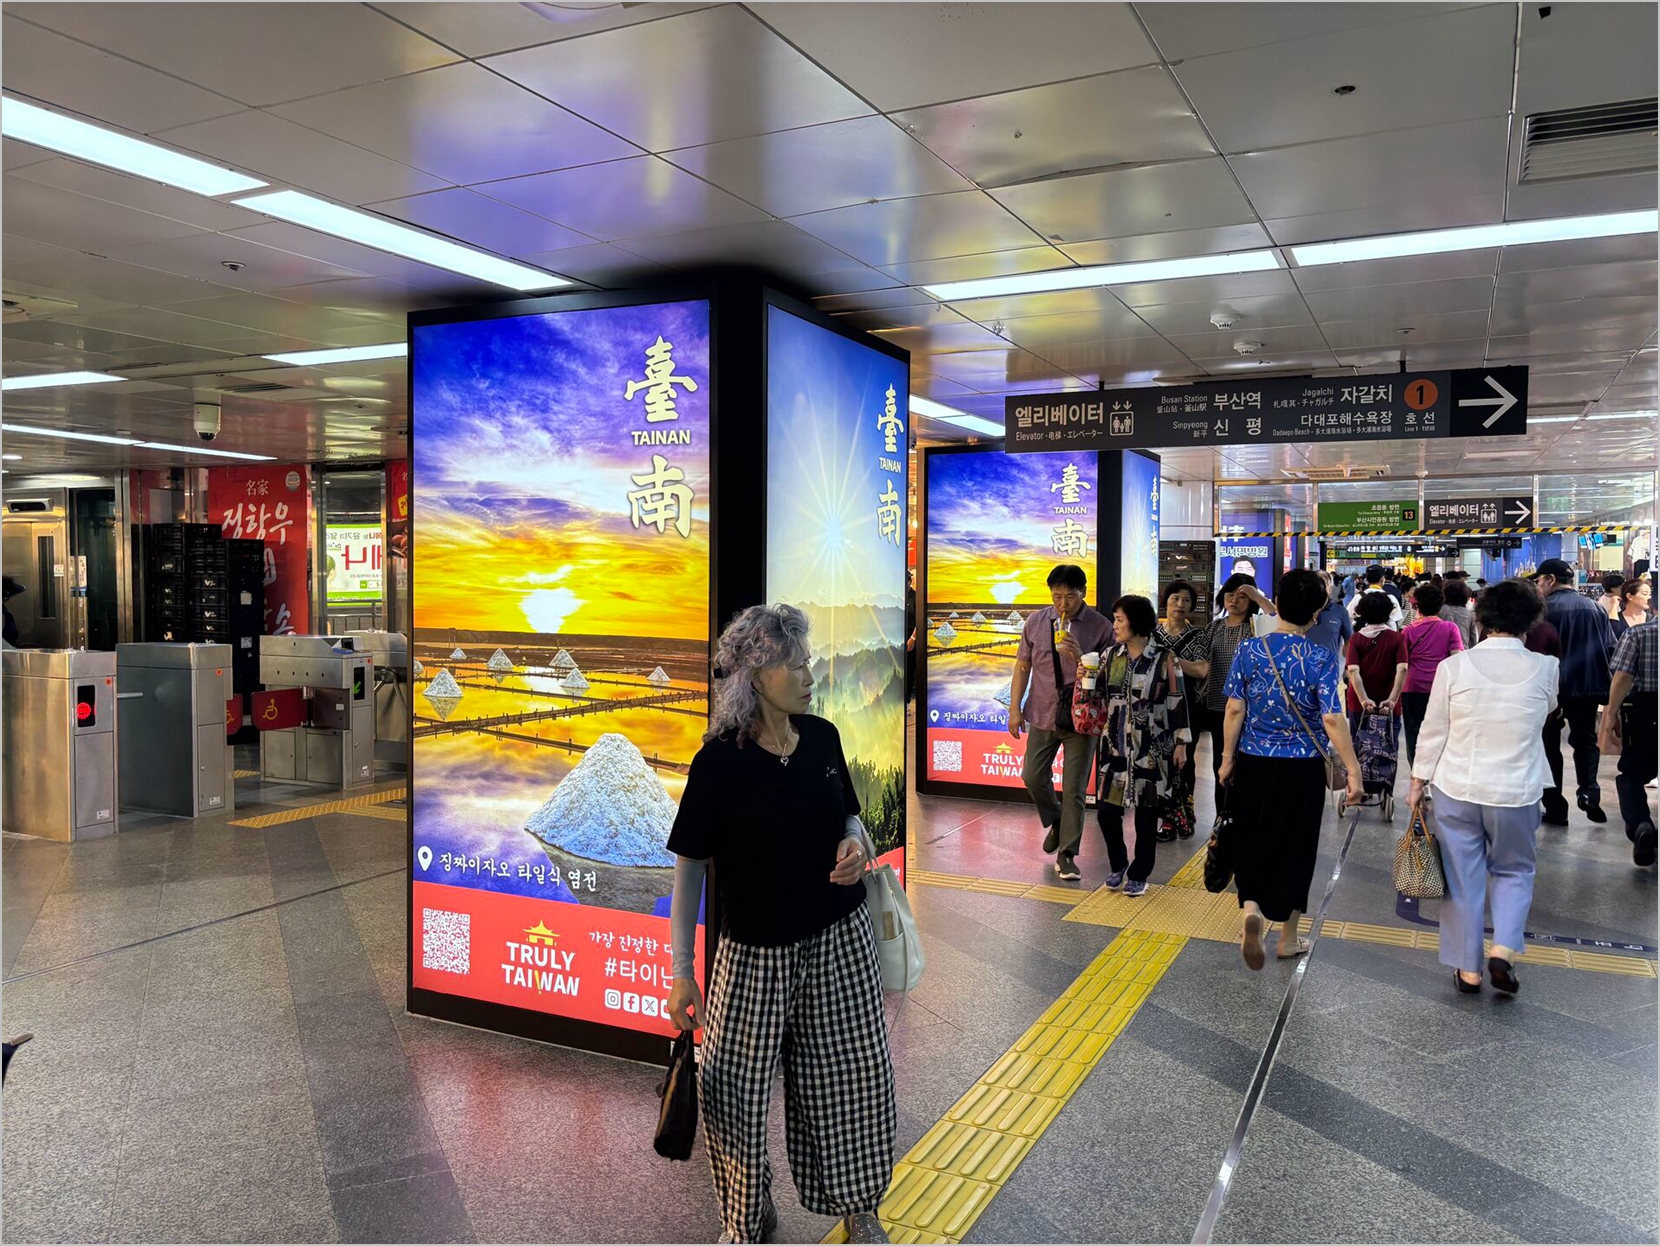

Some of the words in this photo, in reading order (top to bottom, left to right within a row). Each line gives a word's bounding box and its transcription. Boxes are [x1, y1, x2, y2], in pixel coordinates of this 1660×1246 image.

[623, 335, 698, 423] 臺
[1161, 396, 1183, 404] Busan
[1184, 394, 1208, 403] Station
[1213, 391, 1261, 411] 부산역
[1302, 387, 1334, 398] Jagalchi
[1340, 384, 1392, 405] 자갈치
[1416, 385, 1424, 405] 1
[1015, 402, 1103, 428] 엘리베이터
[1301, 410, 1393, 427] 다대포해수욕장
[1172, 421, 1208, 430] Sinpyeong
[1273, 429, 1294, 437] Dadaepo
[1294, 428, 1310, 436] Beach
[631, 430, 691, 446] TAINAN
[1016, 431, 1044, 441] Elevator
[1067, 429, 1103, 439] エレベーター
[879, 457, 901, 473] TAINAN
[245, 479, 269, 496] 名家
[1049, 462, 1091, 504] 臺
[627, 454, 695, 538] 南
[877, 478, 902, 547] 南
[1053, 506, 1087, 514] TAINAN
[1404, 511, 1414, 519] 13
[1429, 504, 1479, 517] 엘리베이터
[1051, 517, 1089, 558] 南
[943, 711, 986, 723] 징짜이자오
[989, 714, 1006, 725] 타일
[983, 753, 1023, 765] TRULY
[439, 852, 511, 877] 징짜이자오
[517, 862, 562, 886] 타일식
[568, 869, 597, 892] 염전
[589, 931, 615, 948] 가장
[619, 934, 659, 956] 진정한
[506, 941, 576, 971] TRULY
[501, 963, 580, 996] TAIWAN
